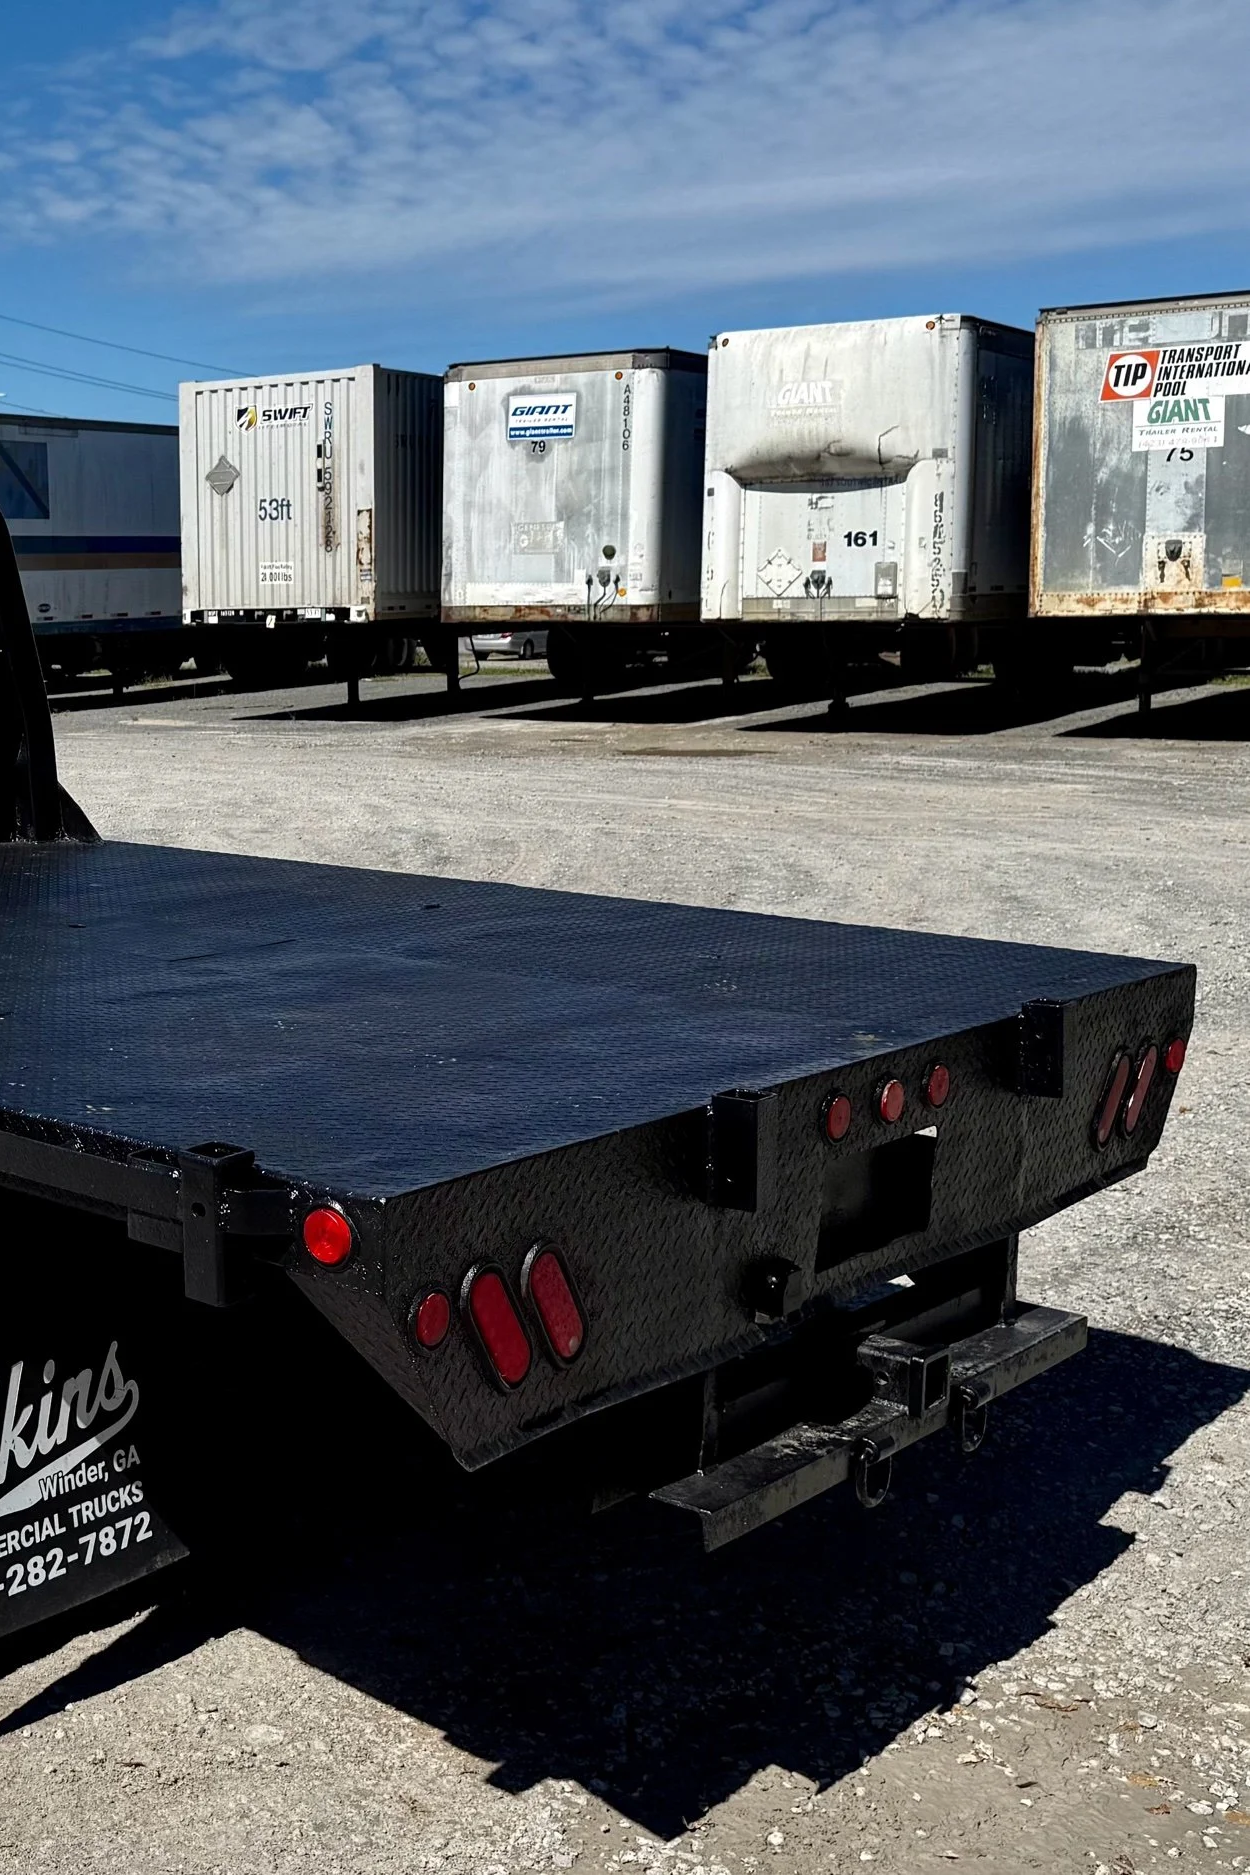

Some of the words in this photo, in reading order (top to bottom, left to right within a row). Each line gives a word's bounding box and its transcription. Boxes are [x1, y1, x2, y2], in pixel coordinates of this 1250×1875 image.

[1161, 344, 1242, 365] TRANSPORT
[1113, 363, 1148, 388] TIP
[777, 381, 832, 405] GIANT
[1153, 381, 1187, 398] POOL
[261, 406, 311, 421] SWIFT
[511, 404, 573, 417] GIANT
[622, 384, 632, 451] A48106
[1147, 398, 1211, 424] GIANT
[1139, 427, 1177, 436] TRAILER
[1182, 425, 1218, 434] RENTAL
[531, 441, 546, 453] 79
[258, 498, 292, 521] 53ft
[844, 530, 878, 547] 161
[39, 1461, 109, 1500] Winder,
[112, 1445, 141, 1473] GA
[68, 1481, 144, 1528] TRUCKS
